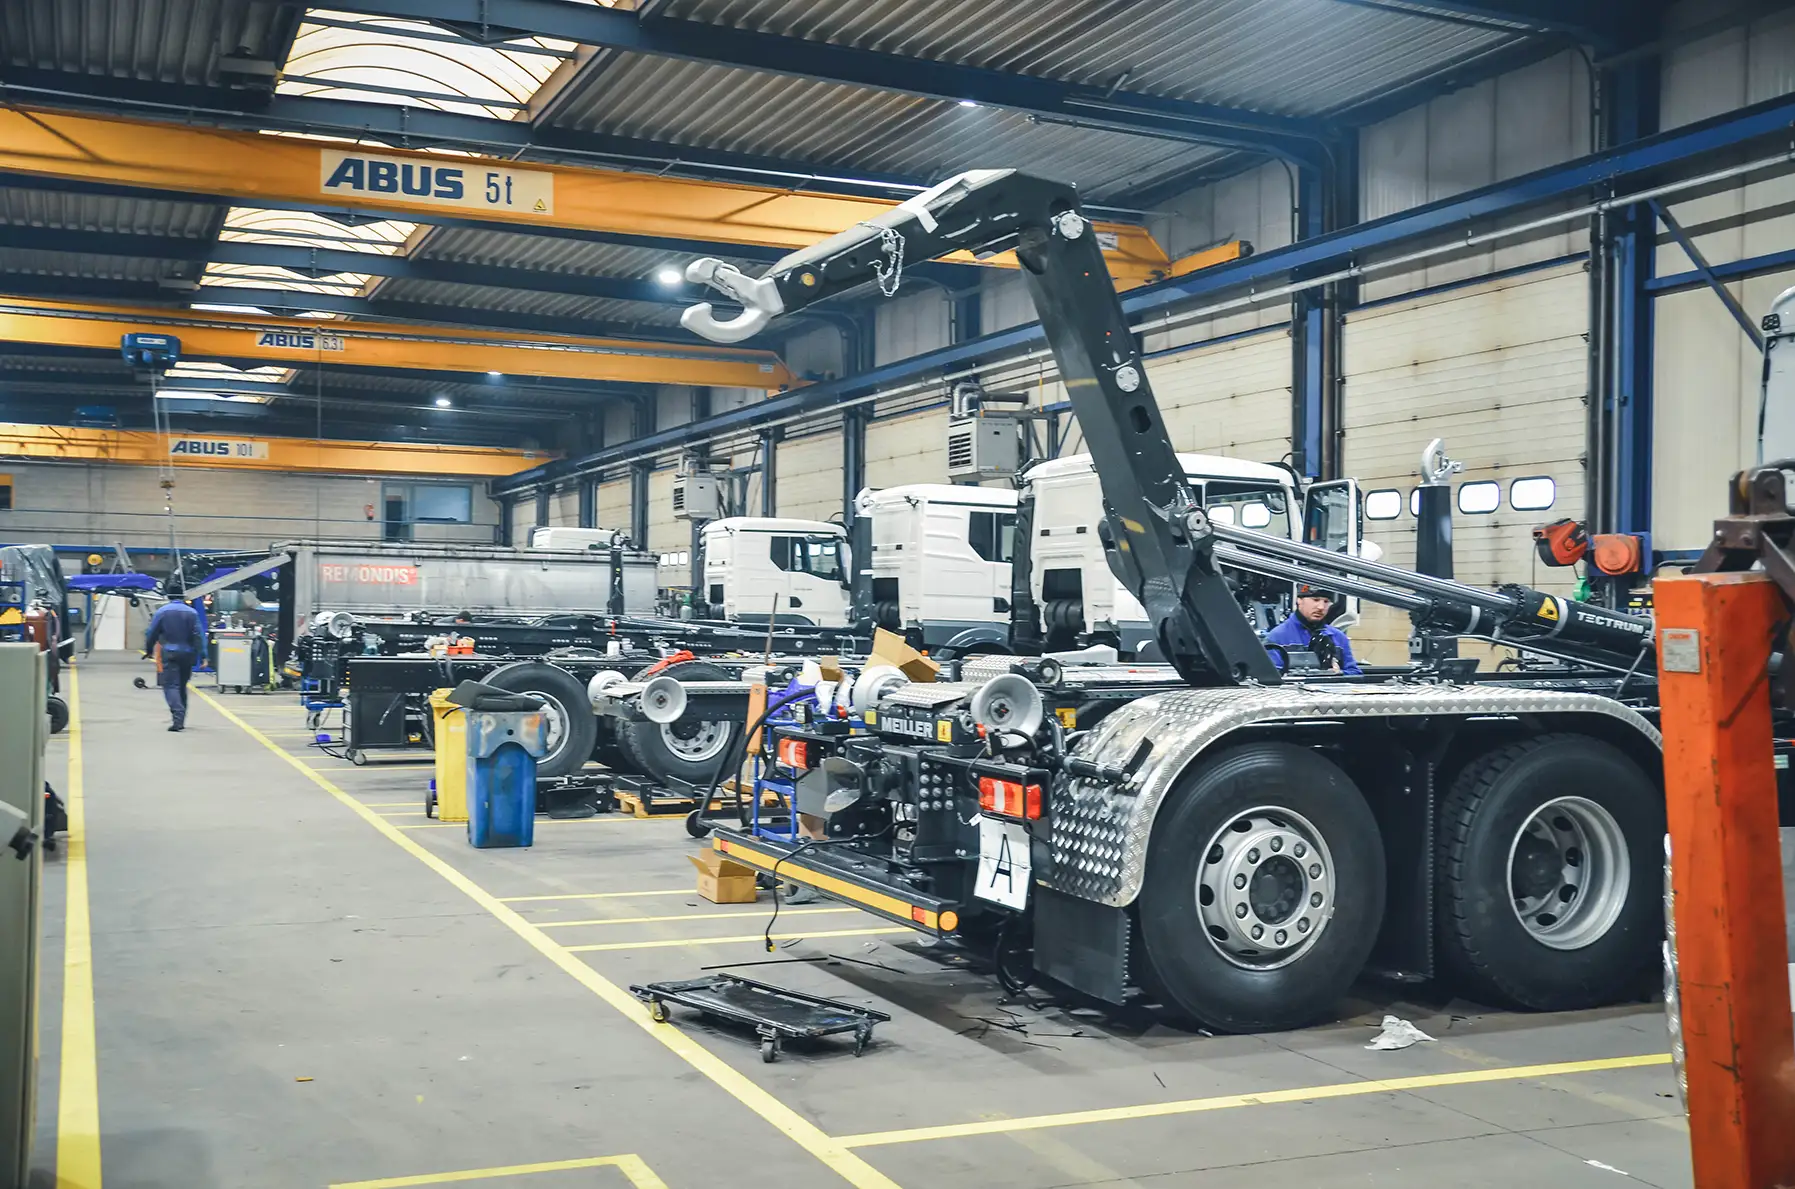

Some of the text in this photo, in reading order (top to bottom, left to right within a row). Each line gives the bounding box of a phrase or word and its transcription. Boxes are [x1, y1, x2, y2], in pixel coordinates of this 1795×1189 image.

[325, 157, 463, 200] ABUS
[258, 333, 314, 349] ABUS
[171, 440, 230, 455] ABUS
[322, 565, 409, 584] REMONDIS
[1576, 611, 1644, 634] TECTRUM
[881, 716, 934, 738] MEILLER
[989, 833, 1012, 893] A
